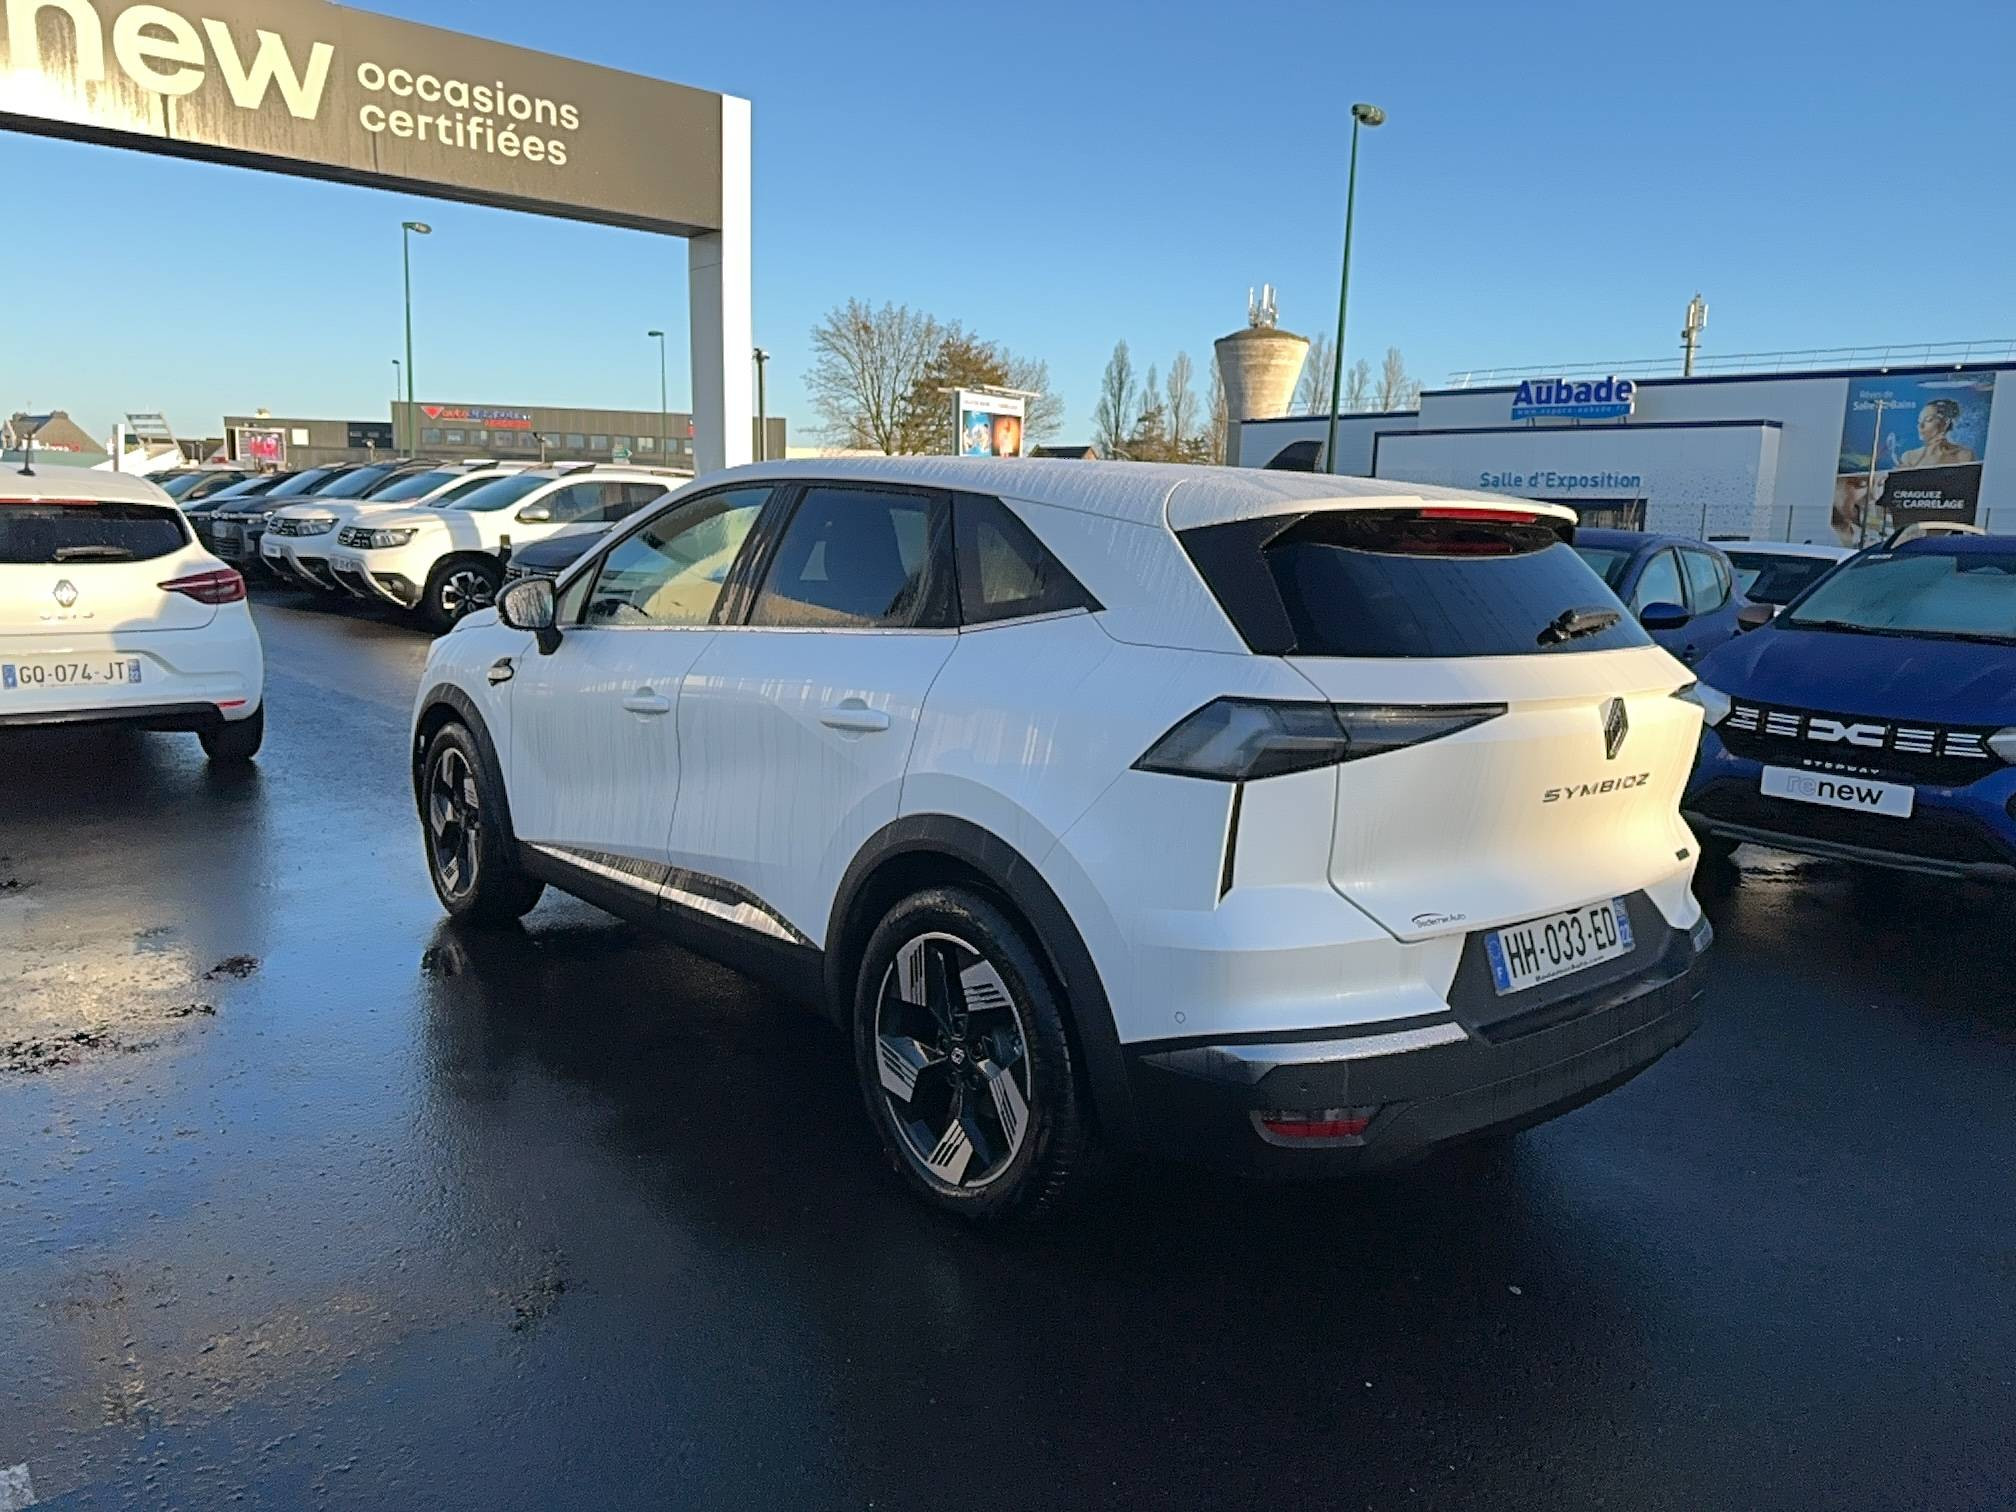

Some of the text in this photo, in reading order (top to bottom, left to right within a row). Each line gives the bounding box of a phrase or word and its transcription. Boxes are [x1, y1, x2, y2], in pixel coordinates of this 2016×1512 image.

[357, 62, 579, 130] occasions
[359, 104, 567, 166] certifiées
[1512, 376, 1632, 406] Aubade
[1480, 472, 1641, 491] Salle d'Exposition
[1903, 500, 1966, 510] CARRELAGE
[20, 662, 125, 684] GQ-074-JT
[1803, 759, 1880, 775] STEPWAY
[1542, 772, 1650, 803] SYMBIOZ
[1786, 774, 1884, 805] renew
[1504, 906, 1618, 978] HH-033-ED
